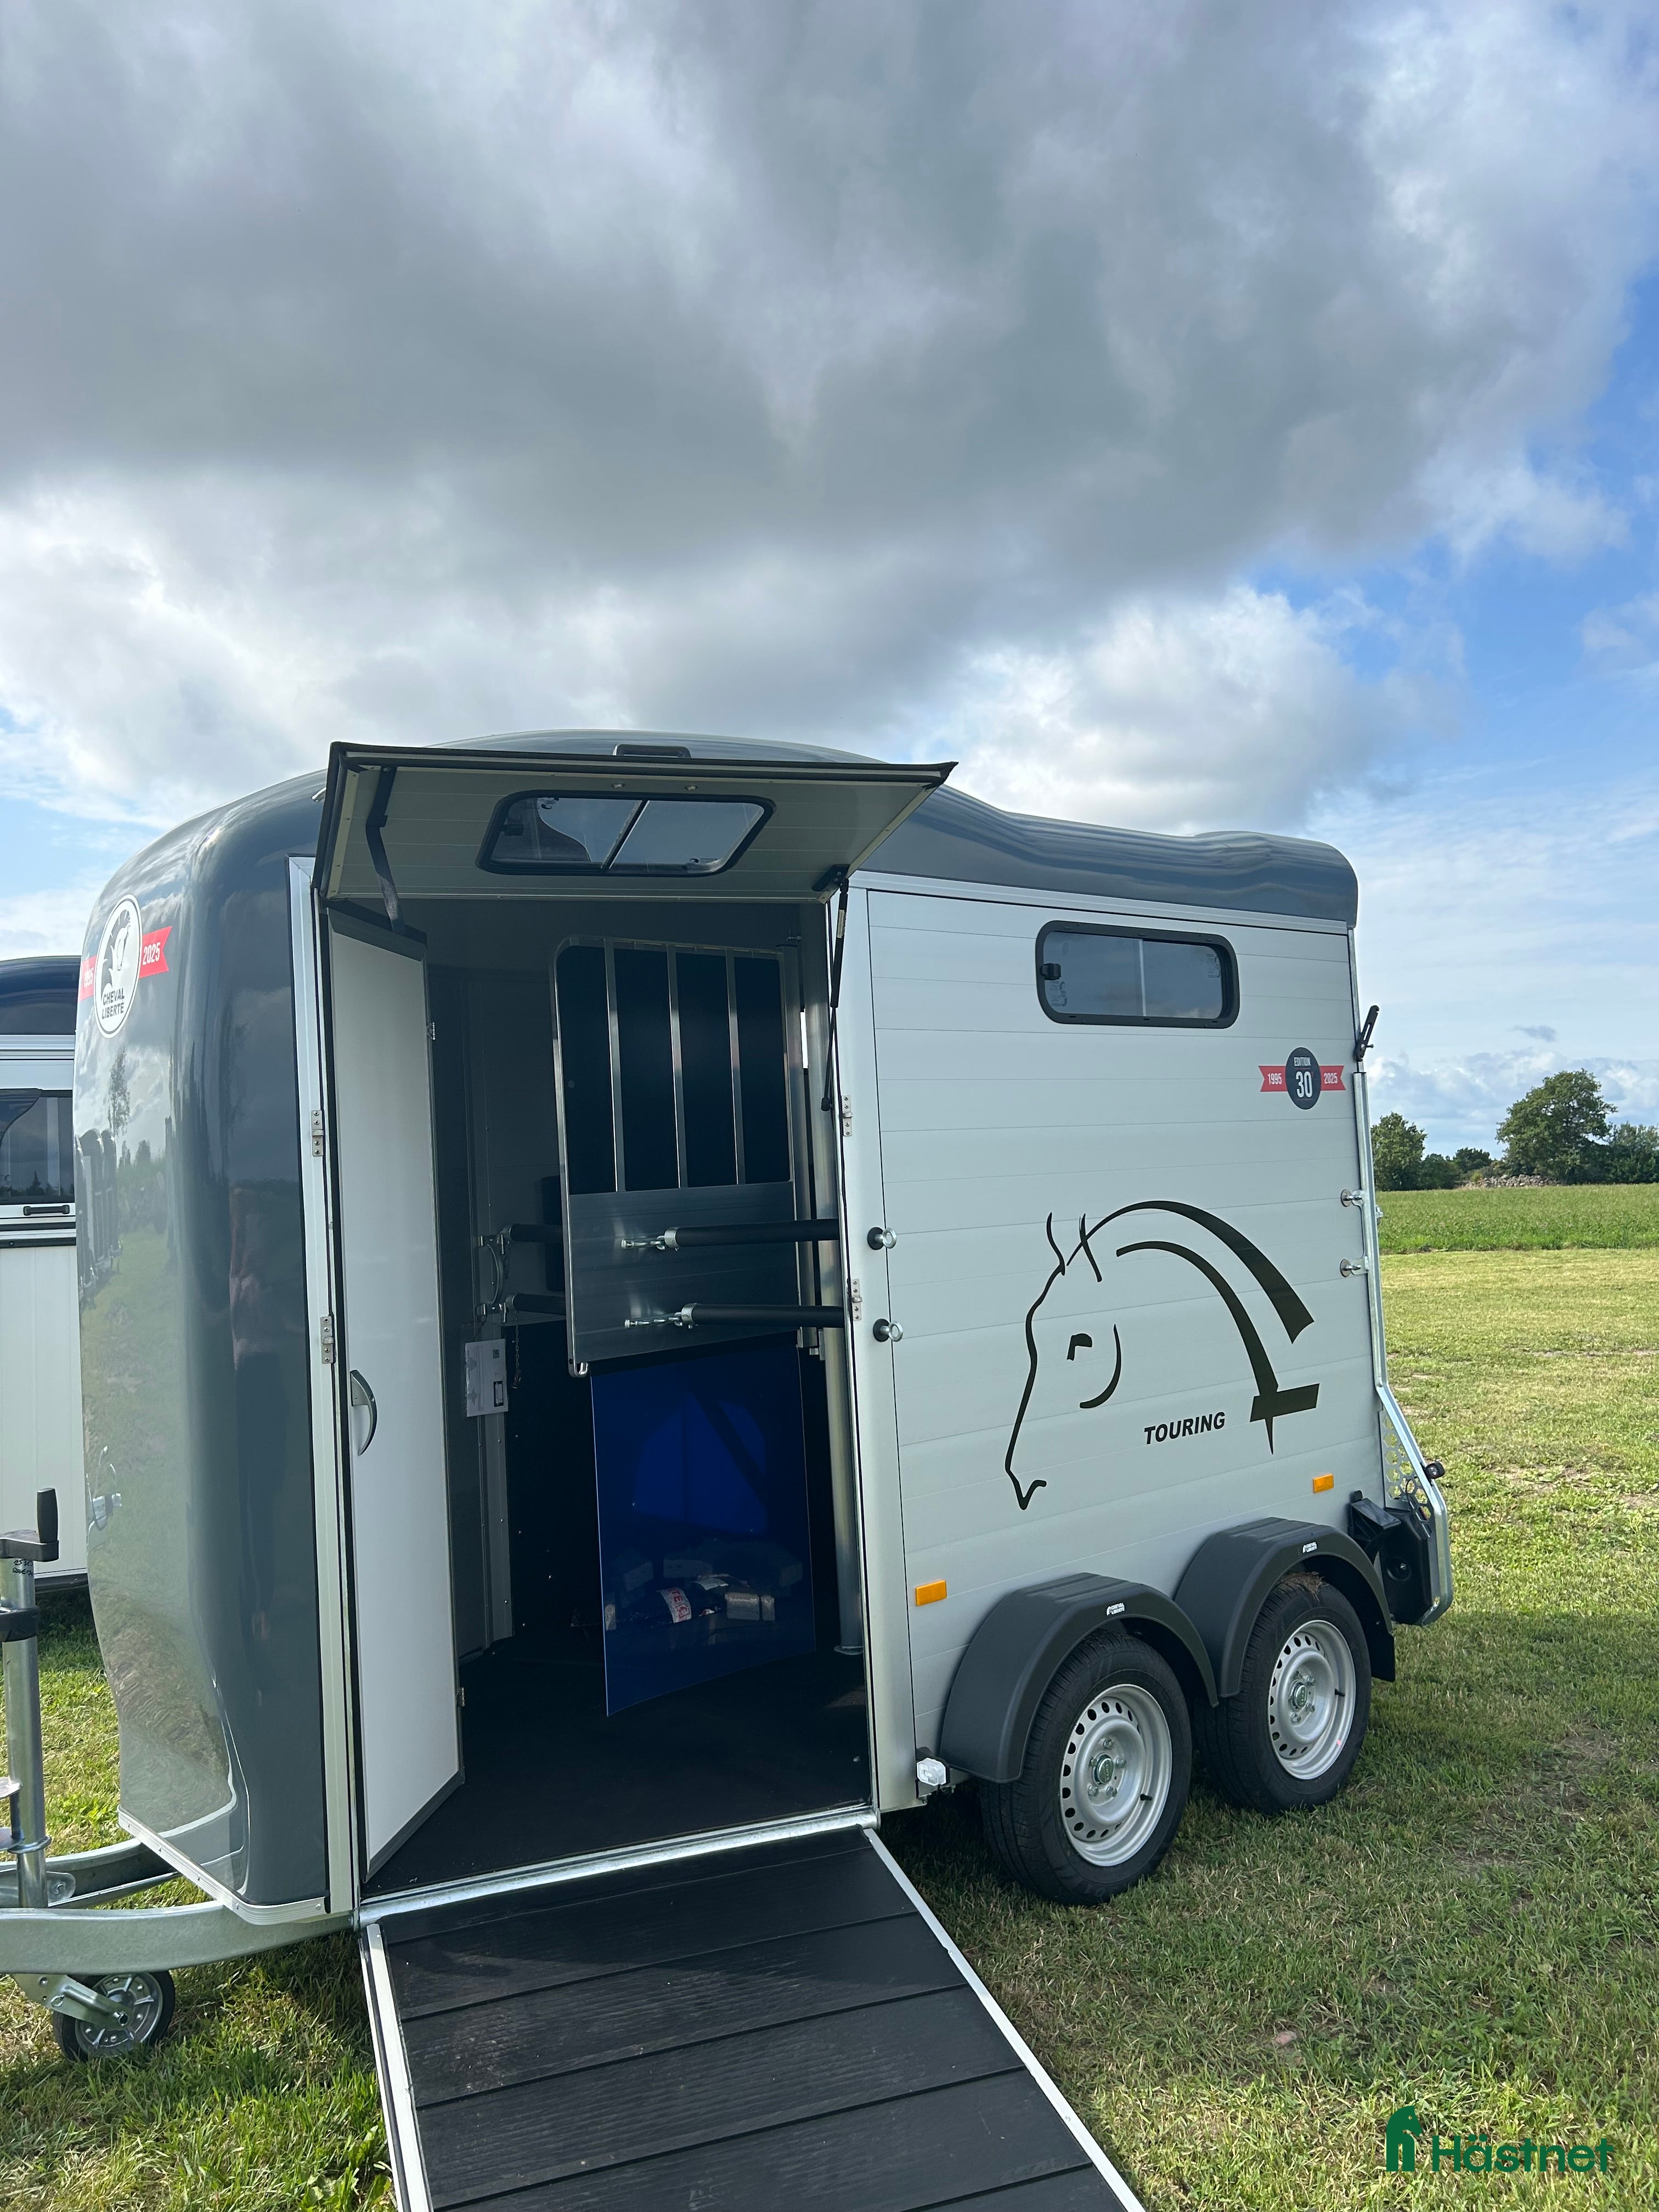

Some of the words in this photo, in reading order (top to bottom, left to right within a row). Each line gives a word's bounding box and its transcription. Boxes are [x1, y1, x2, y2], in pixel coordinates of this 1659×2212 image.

[142, 941, 161, 966] 2025
[83, 967, 94, 988] 1995
[103, 988, 125, 1006] CHEVAL
[101, 1000, 125, 1019] LIBERTÉ
[1294, 1057, 1311, 1066] EDITION
[1267, 1073, 1282, 1085] 1995
[1295, 1071, 1313, 1098] 30
[1323, 1073, 1338, 1084] 2025
[1144, 1412, 1225, 1445] TOURING
